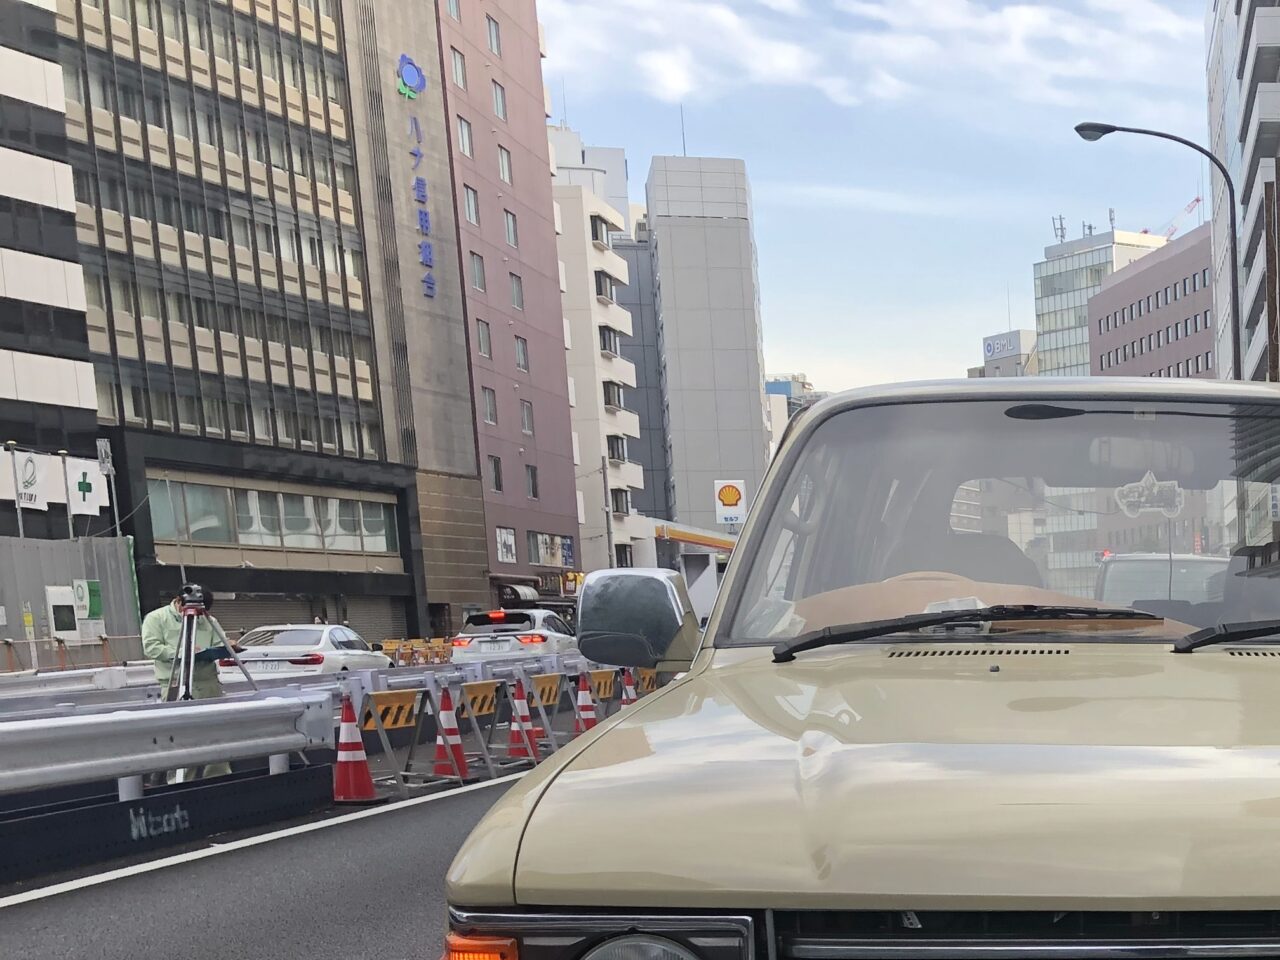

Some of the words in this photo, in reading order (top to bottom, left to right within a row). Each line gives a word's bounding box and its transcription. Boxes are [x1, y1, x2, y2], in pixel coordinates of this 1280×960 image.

[408, 115, 436, 298] ハナ信用組合
[994, 338, 1015, 353] BML
